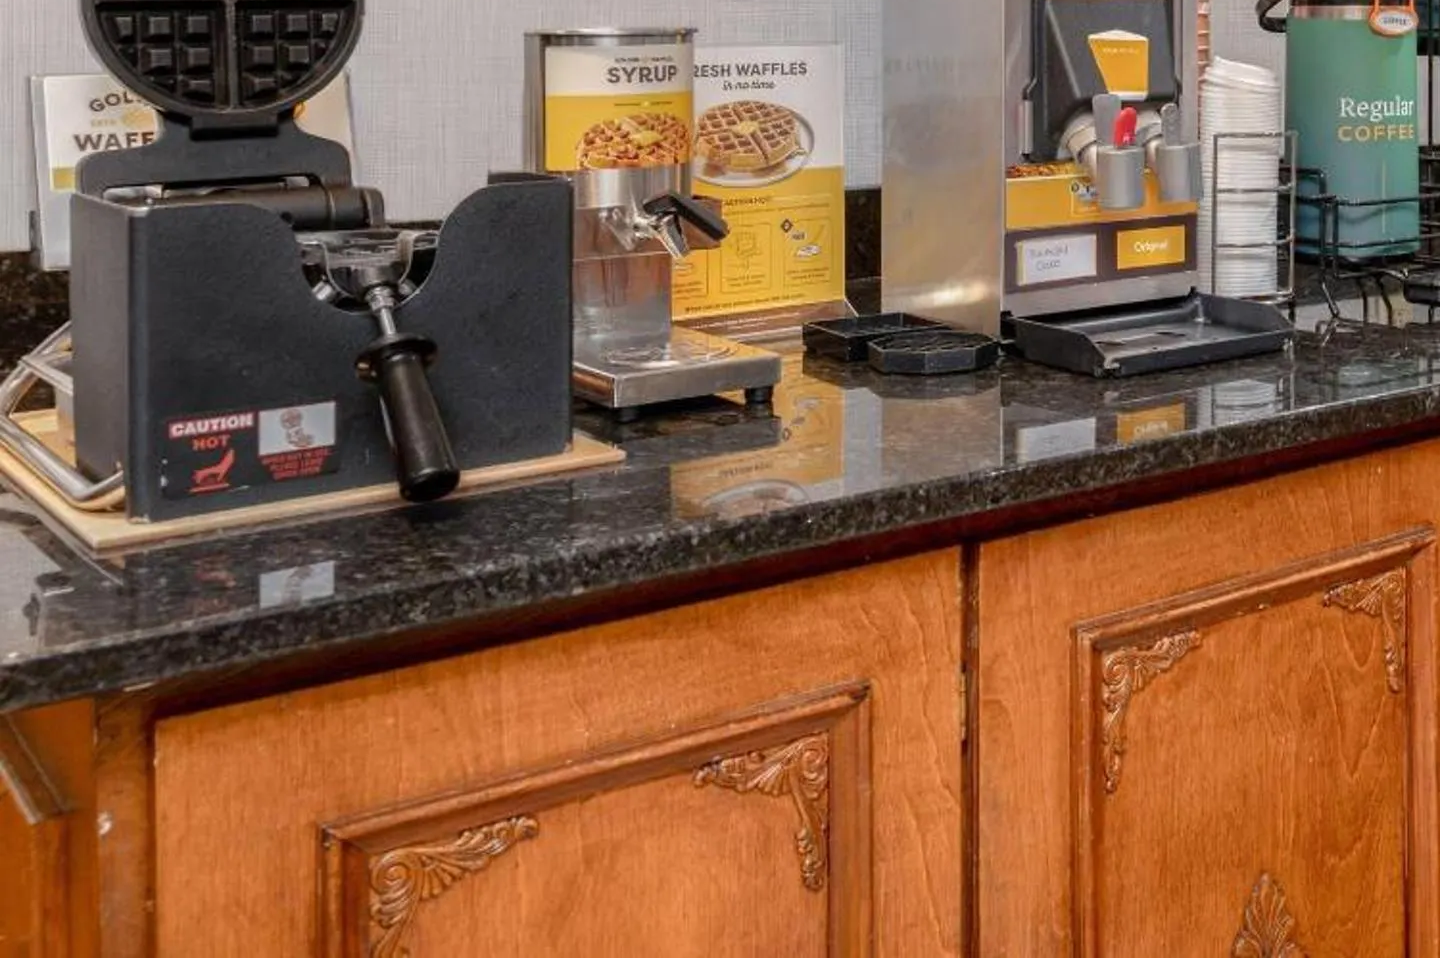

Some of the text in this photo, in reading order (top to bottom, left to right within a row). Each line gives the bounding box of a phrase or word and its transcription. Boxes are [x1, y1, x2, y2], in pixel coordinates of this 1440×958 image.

[607, 65, 677, 84] SYRUP
[693, 62, 807, 78] RESH WAFFLES
[89, 91, 141, 112] GOL
[1339, 95, 1414, 122] Regular
[73, 131, 155, 152] WAFF
[170, 415, 253, 437] CAUTION
[192, 434, 231, 451] HOT
